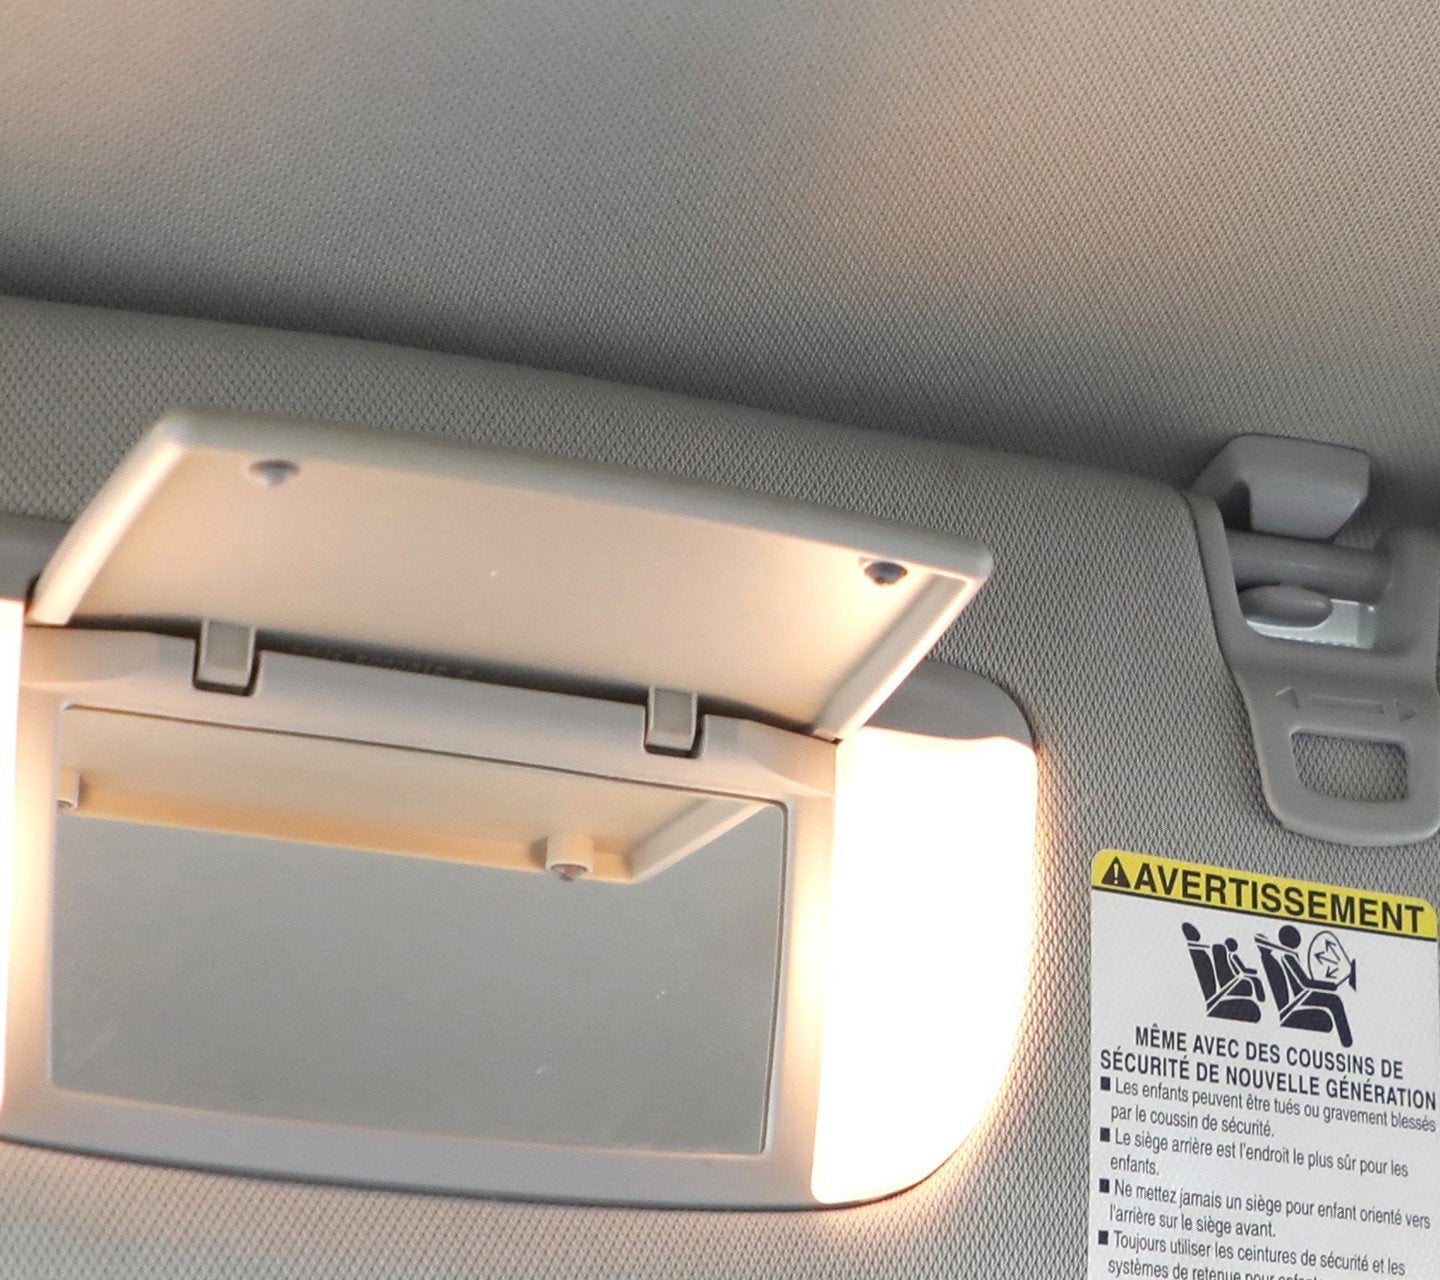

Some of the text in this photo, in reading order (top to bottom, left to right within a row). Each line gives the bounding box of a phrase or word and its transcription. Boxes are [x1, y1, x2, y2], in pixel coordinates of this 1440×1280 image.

[1133, 863, 1425, 934] AVERTISSEMENT
[1135, 1023, 1403, 1079] MÊME AVEC DES COUSSINS DE
[1100, 1046, 1437, 1111] SÉCURITÉ DE NOUVELLE GÉNÉRATION
[1111, 1105, 1275, 1137] par le coussin de sécurité.
[1115, 1077, 1437, 1132] Les enfants peuvent être tués ou gravement blessés
[1110, 1154, 1160, 1176] enfants.
[1115, 1128, 1408, 1177] Le siège arrière est l'endroit le plus sûr pour les
[1109, 1204, 1276, 1238] l'arrière sur le siège avant.
[1114, 1178, 1431, 1229] Ne mettez jamais un siège pour enfant orienté vers
[1108, 1258, 1169, 1279] systèmes
[1172, 1263, 1188, 1280] de
[1113, 1230, 1406, 1276] Toujours utiliser les ceintures de sécurité et les
